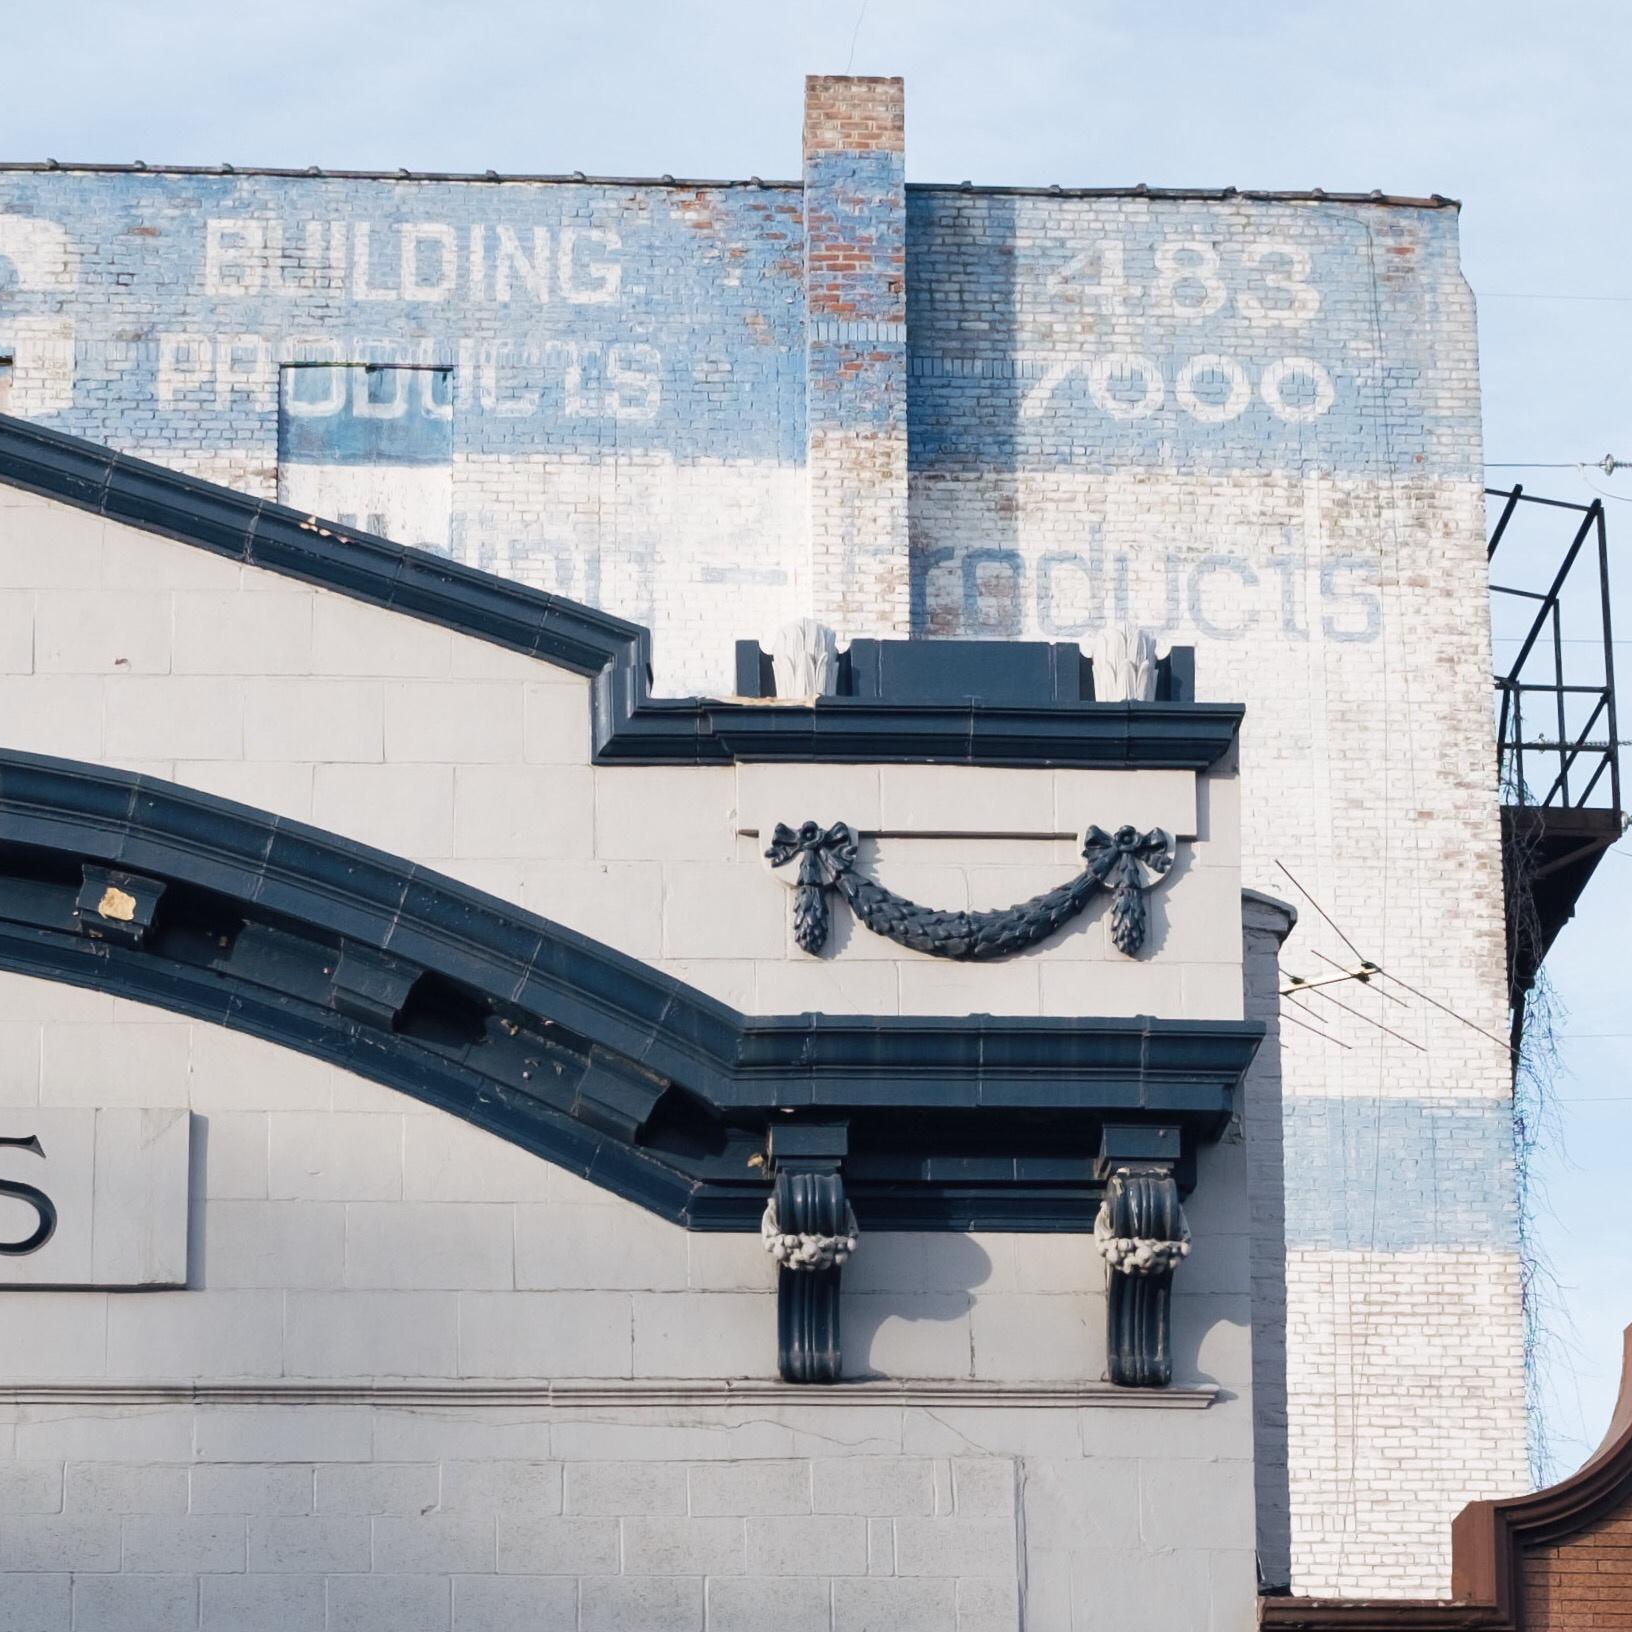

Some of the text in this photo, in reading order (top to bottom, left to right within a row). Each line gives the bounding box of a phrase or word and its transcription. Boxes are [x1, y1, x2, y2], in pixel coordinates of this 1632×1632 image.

[204, 217, 623, 307] BUILDING
[1046, 239, 1321, 322] 483
[156, 331, 662, 420] PRODUCTS
[1016, 350, 1335, 424] 7000
